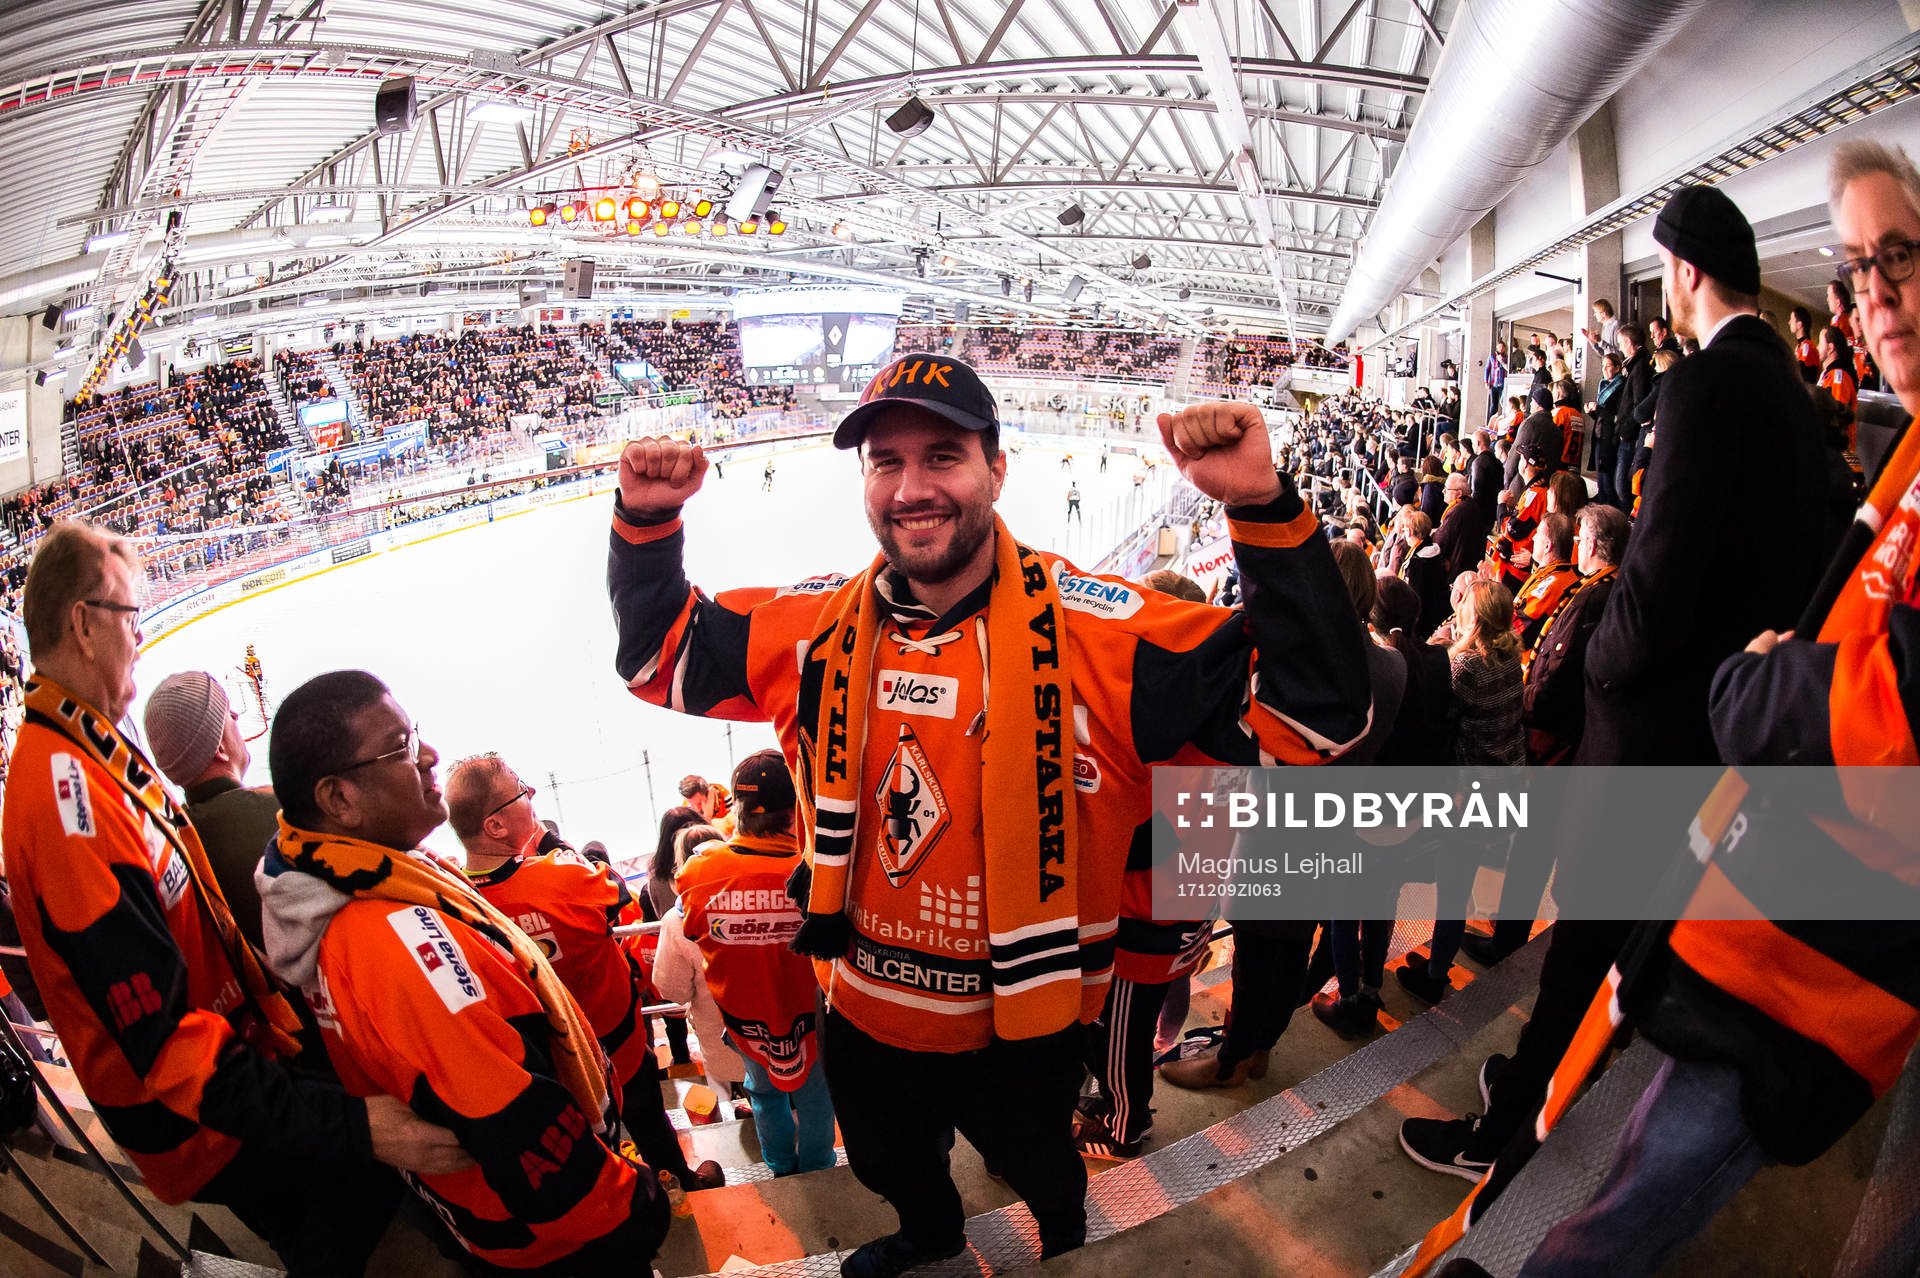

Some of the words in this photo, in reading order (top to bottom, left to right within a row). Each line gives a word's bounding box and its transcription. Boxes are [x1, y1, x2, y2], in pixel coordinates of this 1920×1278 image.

[1192, 546, 1235, 577] Hem
[1063, 576, 1130, 605] STENA
[1029, 603, 1059, 671] VI
[825, 603, 861, 784] TILLS
[909, 744, 947, 815] KARLSKRONA
[1034, 683, 1065, 903] STARKA
[923, 809, 936, 819] 01
[414, 907, 446, 939] Line
[438, 941, 478, 998] Stena
[856, 948, 981, 993] BILCENTER
[741, 1020, 805, 1057] stdium
[520, 1103, 587, 1191] ABB
